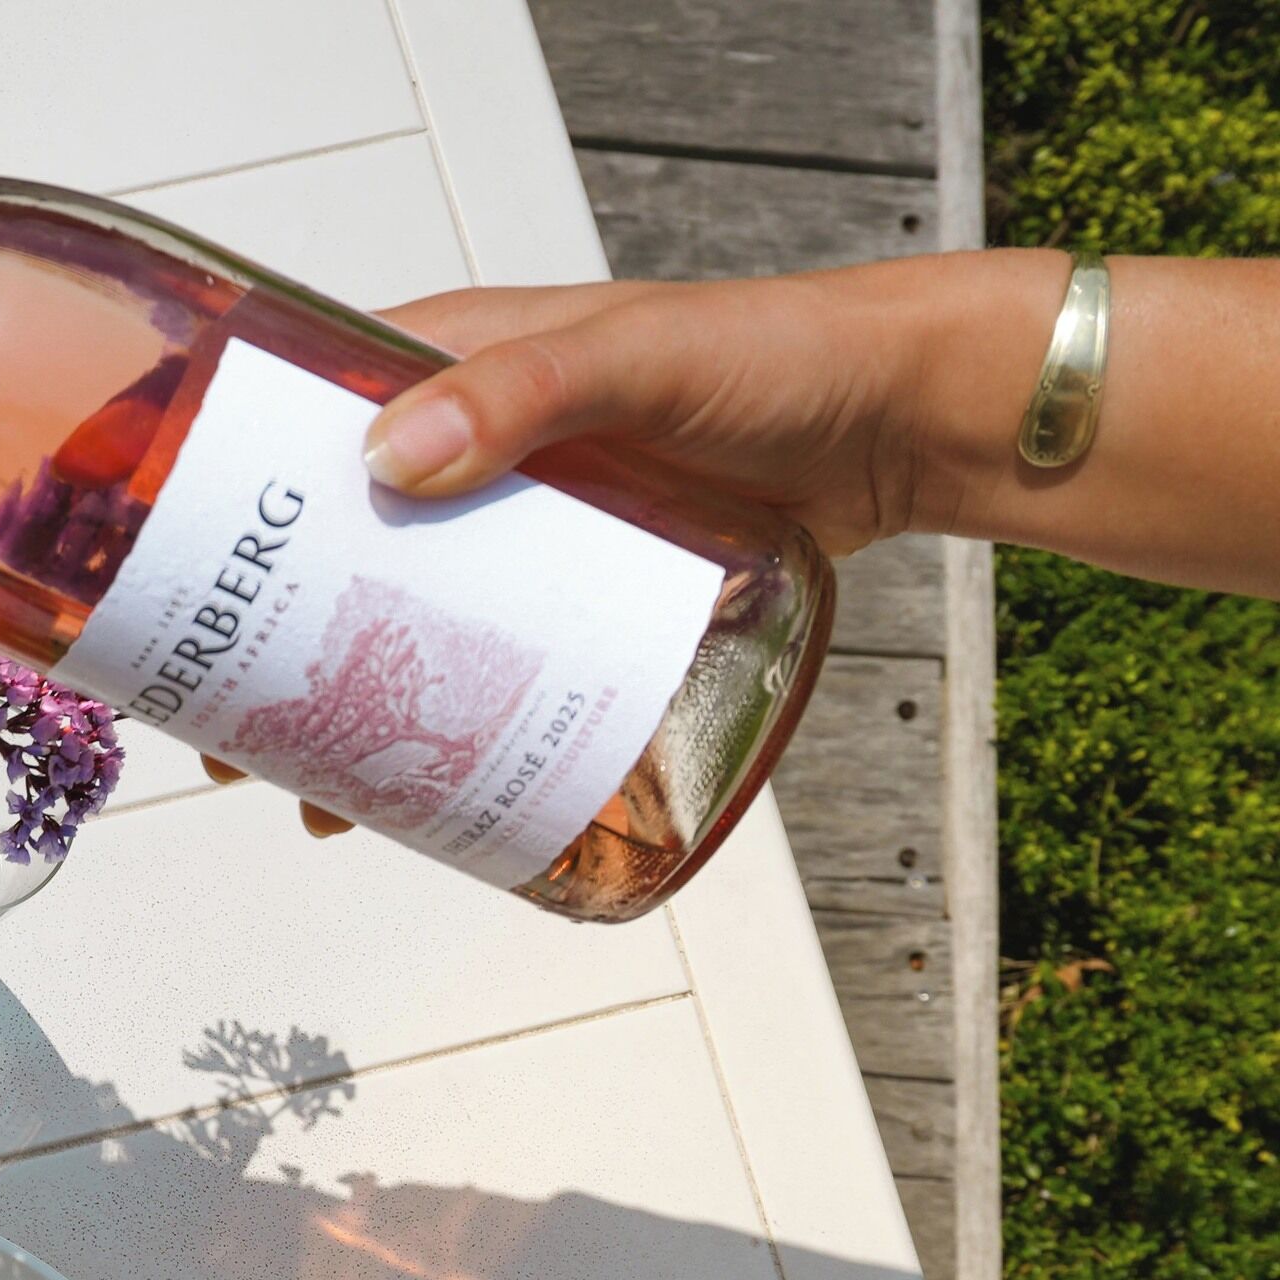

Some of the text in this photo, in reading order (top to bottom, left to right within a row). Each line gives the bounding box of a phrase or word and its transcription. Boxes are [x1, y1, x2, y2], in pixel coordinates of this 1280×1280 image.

[122, 478, 304, 727] EDERBERG
[237, 582, 300, 672] AFRICA
[442, 810, 501, 856] SHIRAZ
[494, 750, 547, 809] ROSÉ
[541, 690, 585, 748] 2025
